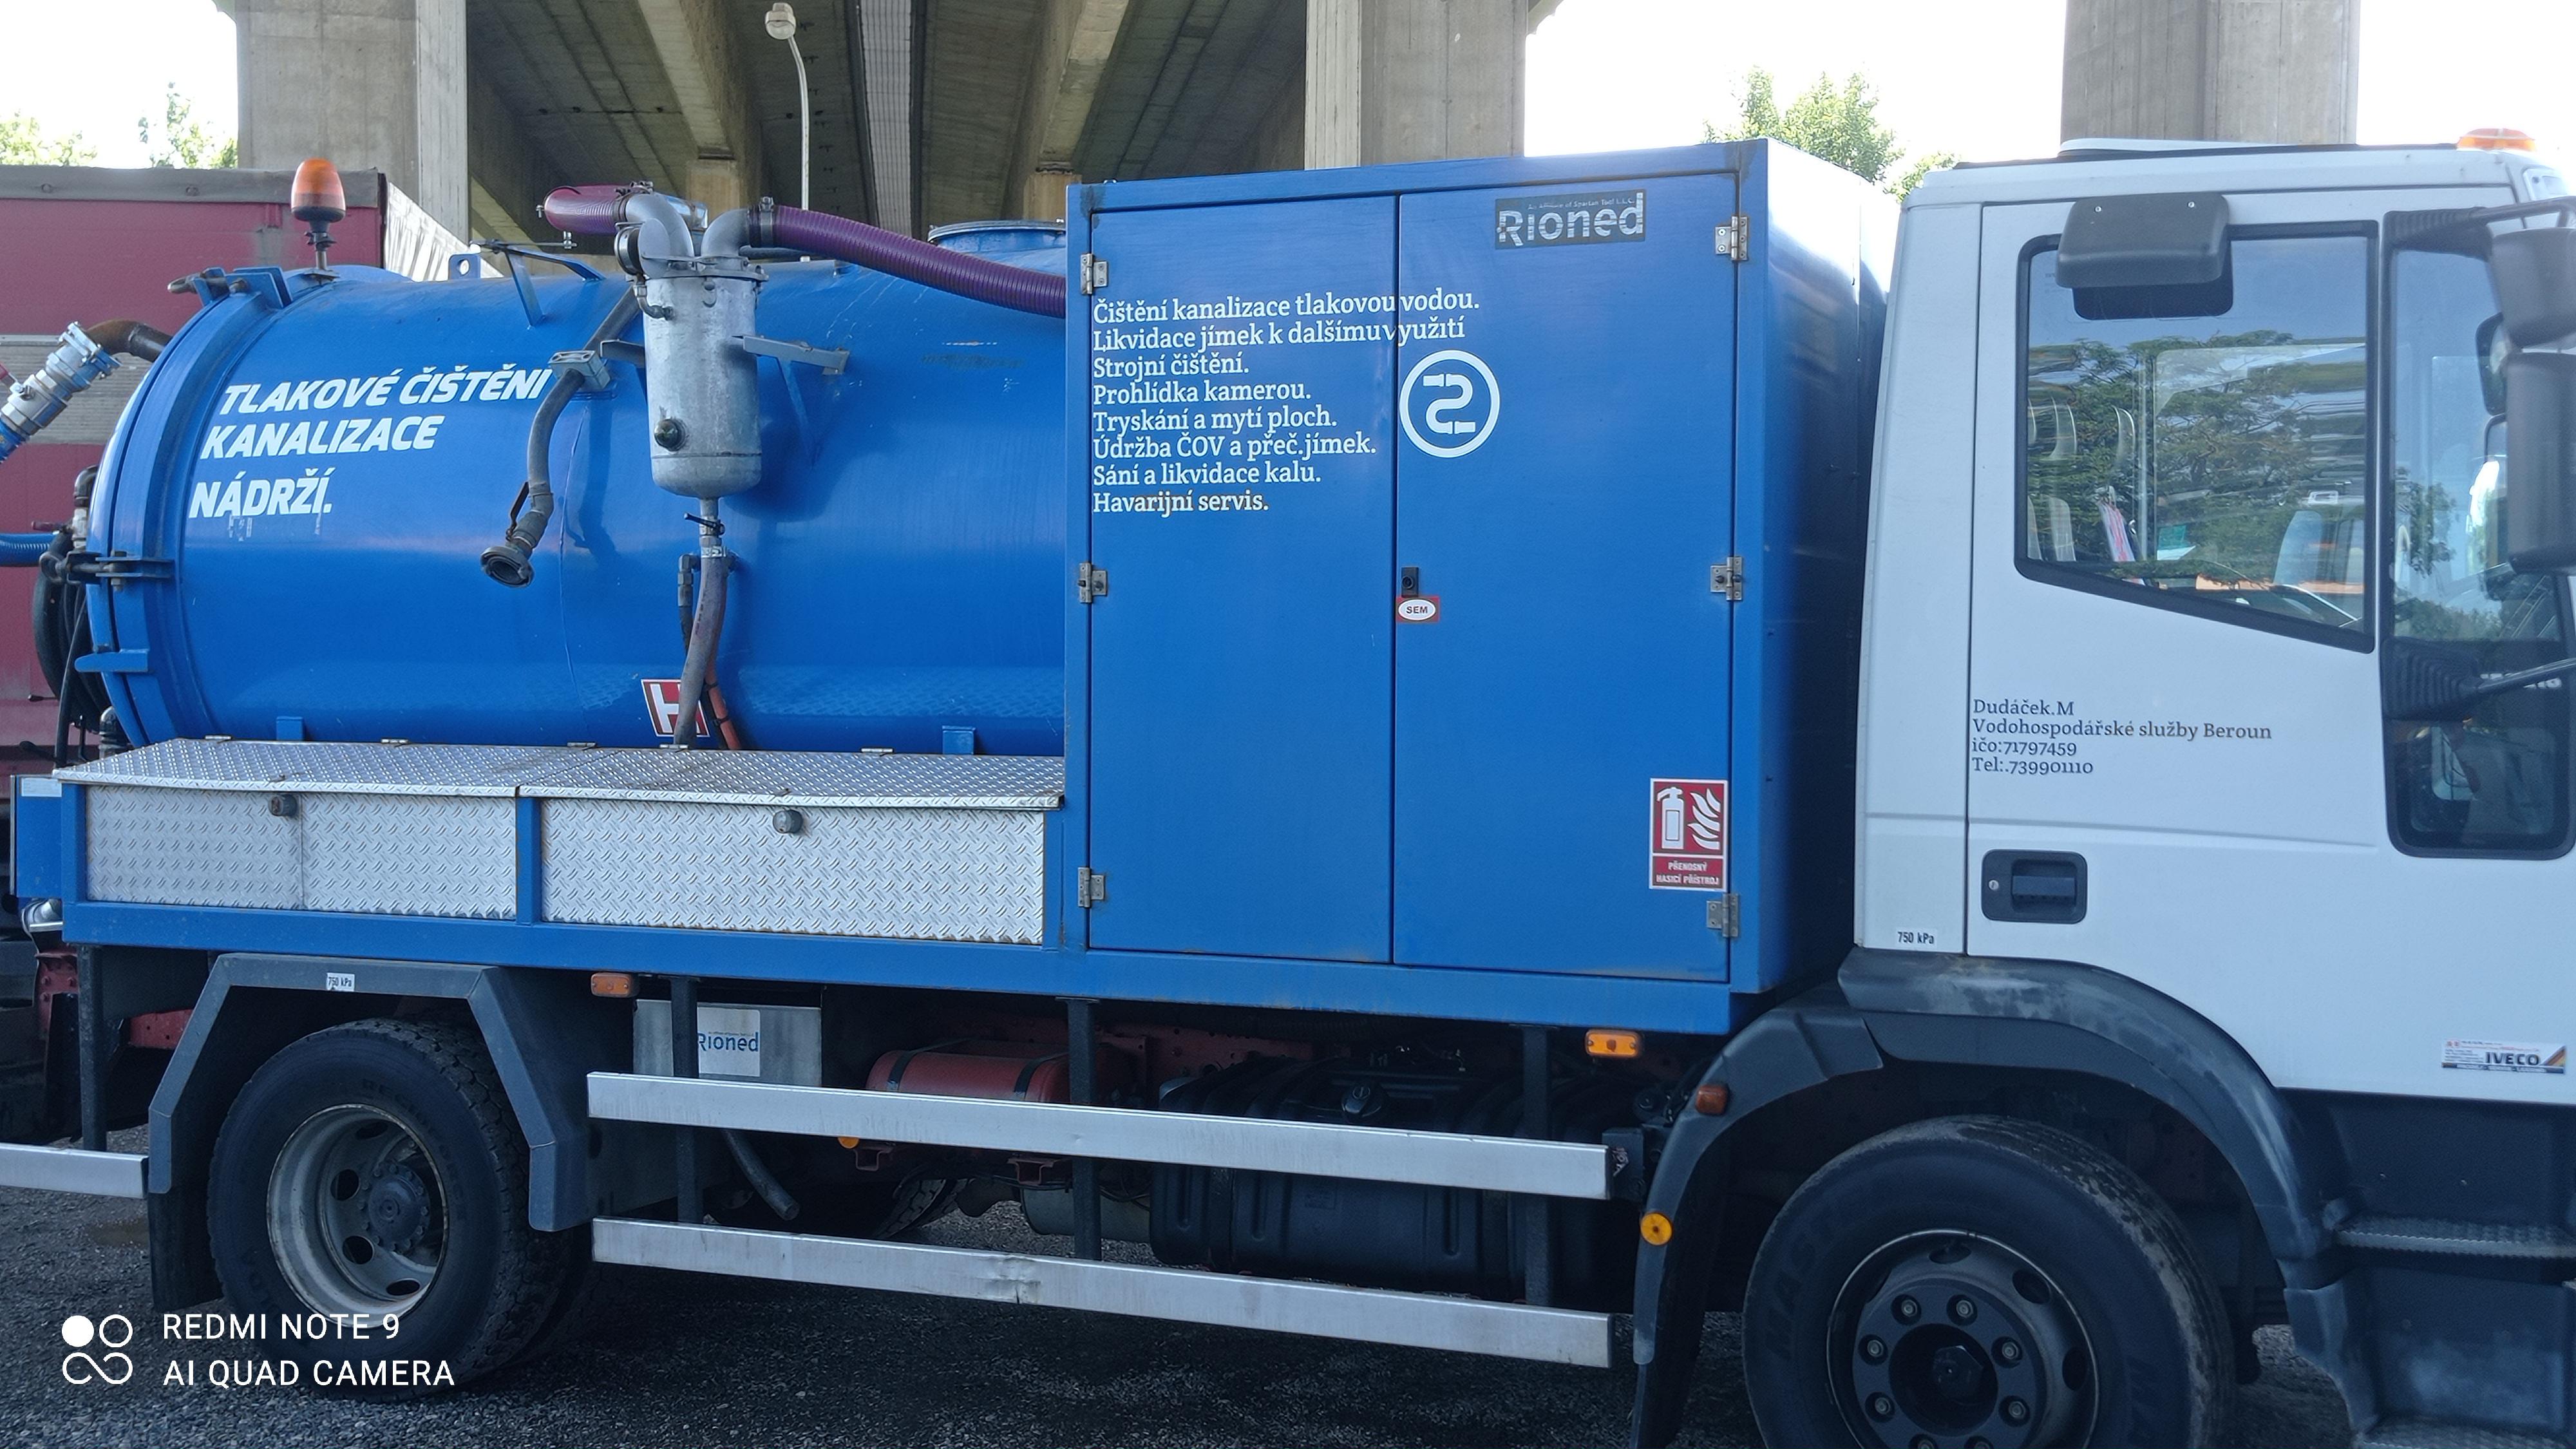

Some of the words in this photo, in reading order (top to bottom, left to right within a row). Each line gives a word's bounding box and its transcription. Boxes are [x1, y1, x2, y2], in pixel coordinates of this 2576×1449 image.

[1497, 192, 1643, 246] Rioned
[1094, 298, 1168, 324] Čištění
[1172, 296, 1291, 320] kanalizace
[1295, 292, 1396, 316] tlakovou
[1400, 287, 1480, 312] vodou.
[1094, 327, 1196, 352] Likvidace
[1198, 322, 1264, 354] jímek
[1267, 322, 1284, 345] k
[1288, 319, 1381, 344] dalšímu
[1094, 354, 1166, 383] Strojní
[1170, 351, 1249, 376] čištění.
[219, 368, 404, 415] TLAKOVÉ
[1093, 380, 1199, 406] Prohlídka
[1203, 380, 1312, 402] kamerou.
[1093, 406, 1189, 437] Tryskání
[1193, 413, 1207, 430] a
[1211, 406, 1263, 435] mytí
[1267, 404, 1338, 433] ploch.
[200, 415, 445, 460] KANALIZACE
[1093, 435, 1172, 459] Údržba
[1177, 433, 1226, 457] ČOV
[1229, 440, 1243, 456] a
[1093, 463, 1140, 486] Sání
[1143, 468, 1157, 484] a
[1160, 462, 1260, 484] likvidace
[1264, 460, 1321, 483] kalu.
[189, 468, 336, 518] NÁDRŽÍ.
[1093, 489, 1194, 518] Havarijní
[1198, 490, 1269, 511] servis.
[1973, 718, 2134, 739] Vodohospodářské
[2139, 720, 2198, 741] služby
[2203, 722, 2272, 739] Beroun
[1971, 737, 2078, 756] ičo:71797459
[1897, 931, 1915, 943] 750
[1917, 932, 1935, 945] kPa
[328, 976, 339, 987] 750
[2485, 1051, 2541, 1066] IVECO
